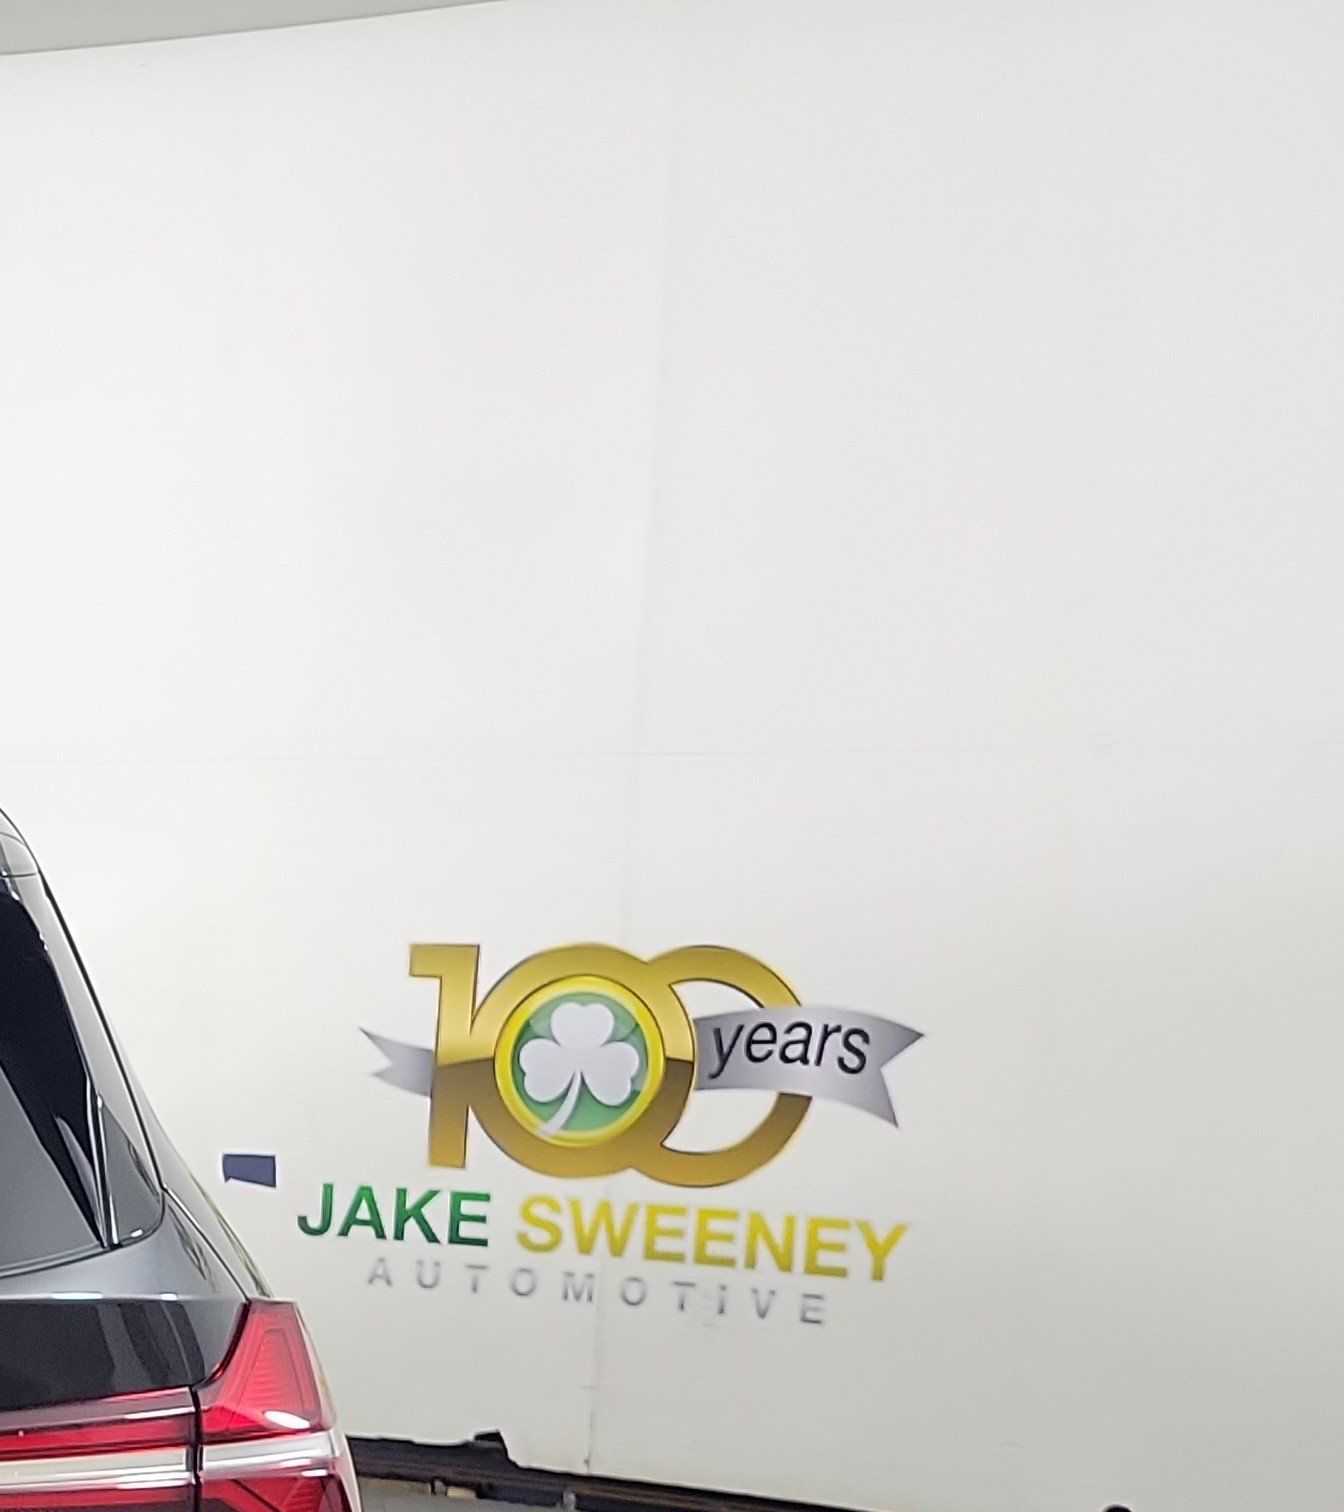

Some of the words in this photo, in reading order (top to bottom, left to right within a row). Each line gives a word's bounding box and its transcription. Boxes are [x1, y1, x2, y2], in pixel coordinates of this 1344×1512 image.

[706, 1019, 872, 1079] years
[296, 1181, 493, 1248] JAKE
[515, 1194, 909, 1283] SWEENEY
[366, 1256, 829, 1326] AUTOMOTIVE
